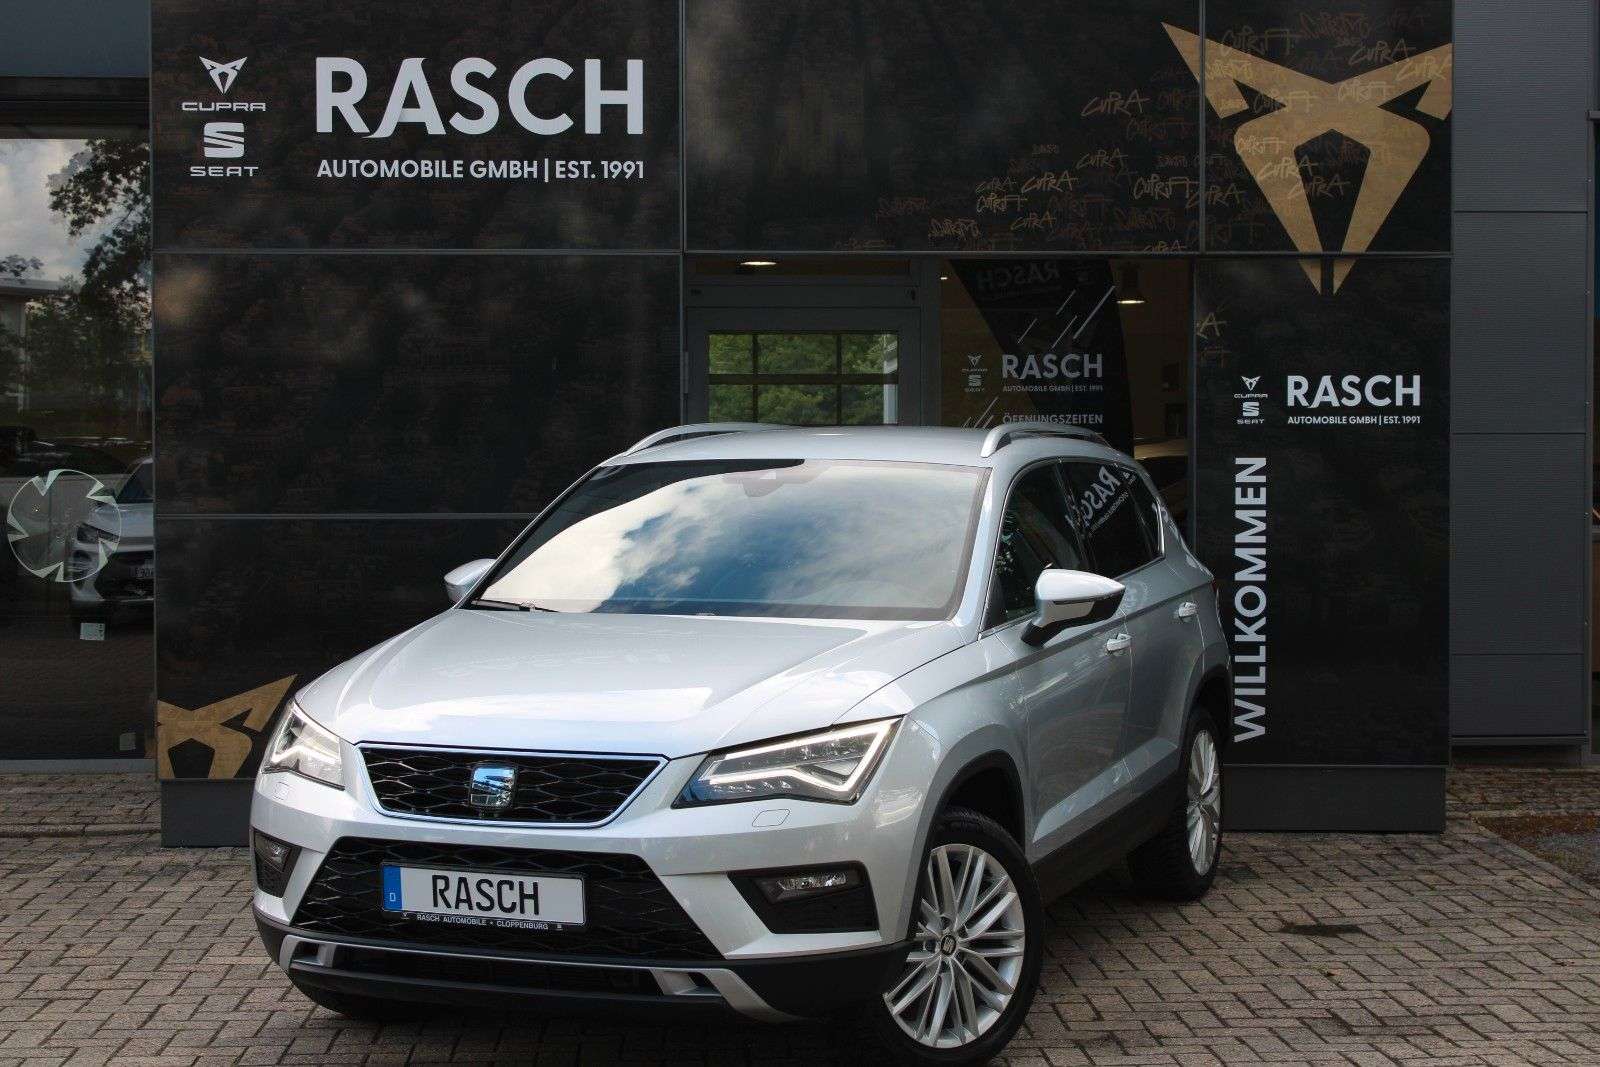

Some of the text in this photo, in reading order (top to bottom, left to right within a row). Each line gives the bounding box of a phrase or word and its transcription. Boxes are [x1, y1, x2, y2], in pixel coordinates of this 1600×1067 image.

[182, 102, 267, 113] CUPRA
[316, 56, 644, 139] RASCH
[1080, 88, 1150, 117] CUPRA
[190, 166, 259, 178] SEAT
[316, 159, 645, 180] AUTOMOBILE GMBH EST. 1991
[1257, 154, 1319, 181] CUPRA
[1020, 170, 1078, 193] CUPRA
[1001, 353, 1104, 380] RASCH
[1287, 374, 1421, 409] RASCH
[1002, 412, 1104, 425] ÖFFNUNGSZEITEN
[1287, 415, 1421, 425] AUTOMOBILE GMBH EST. 1991
[1234, 457, 1267, 743] WILLKOMMEN
[389, 892, 396, 902] D
[431, 874, 540, 916] RASCH
[416, 913, 549, 930] RASCH AUTOMOBILE CLOPPENBURG
